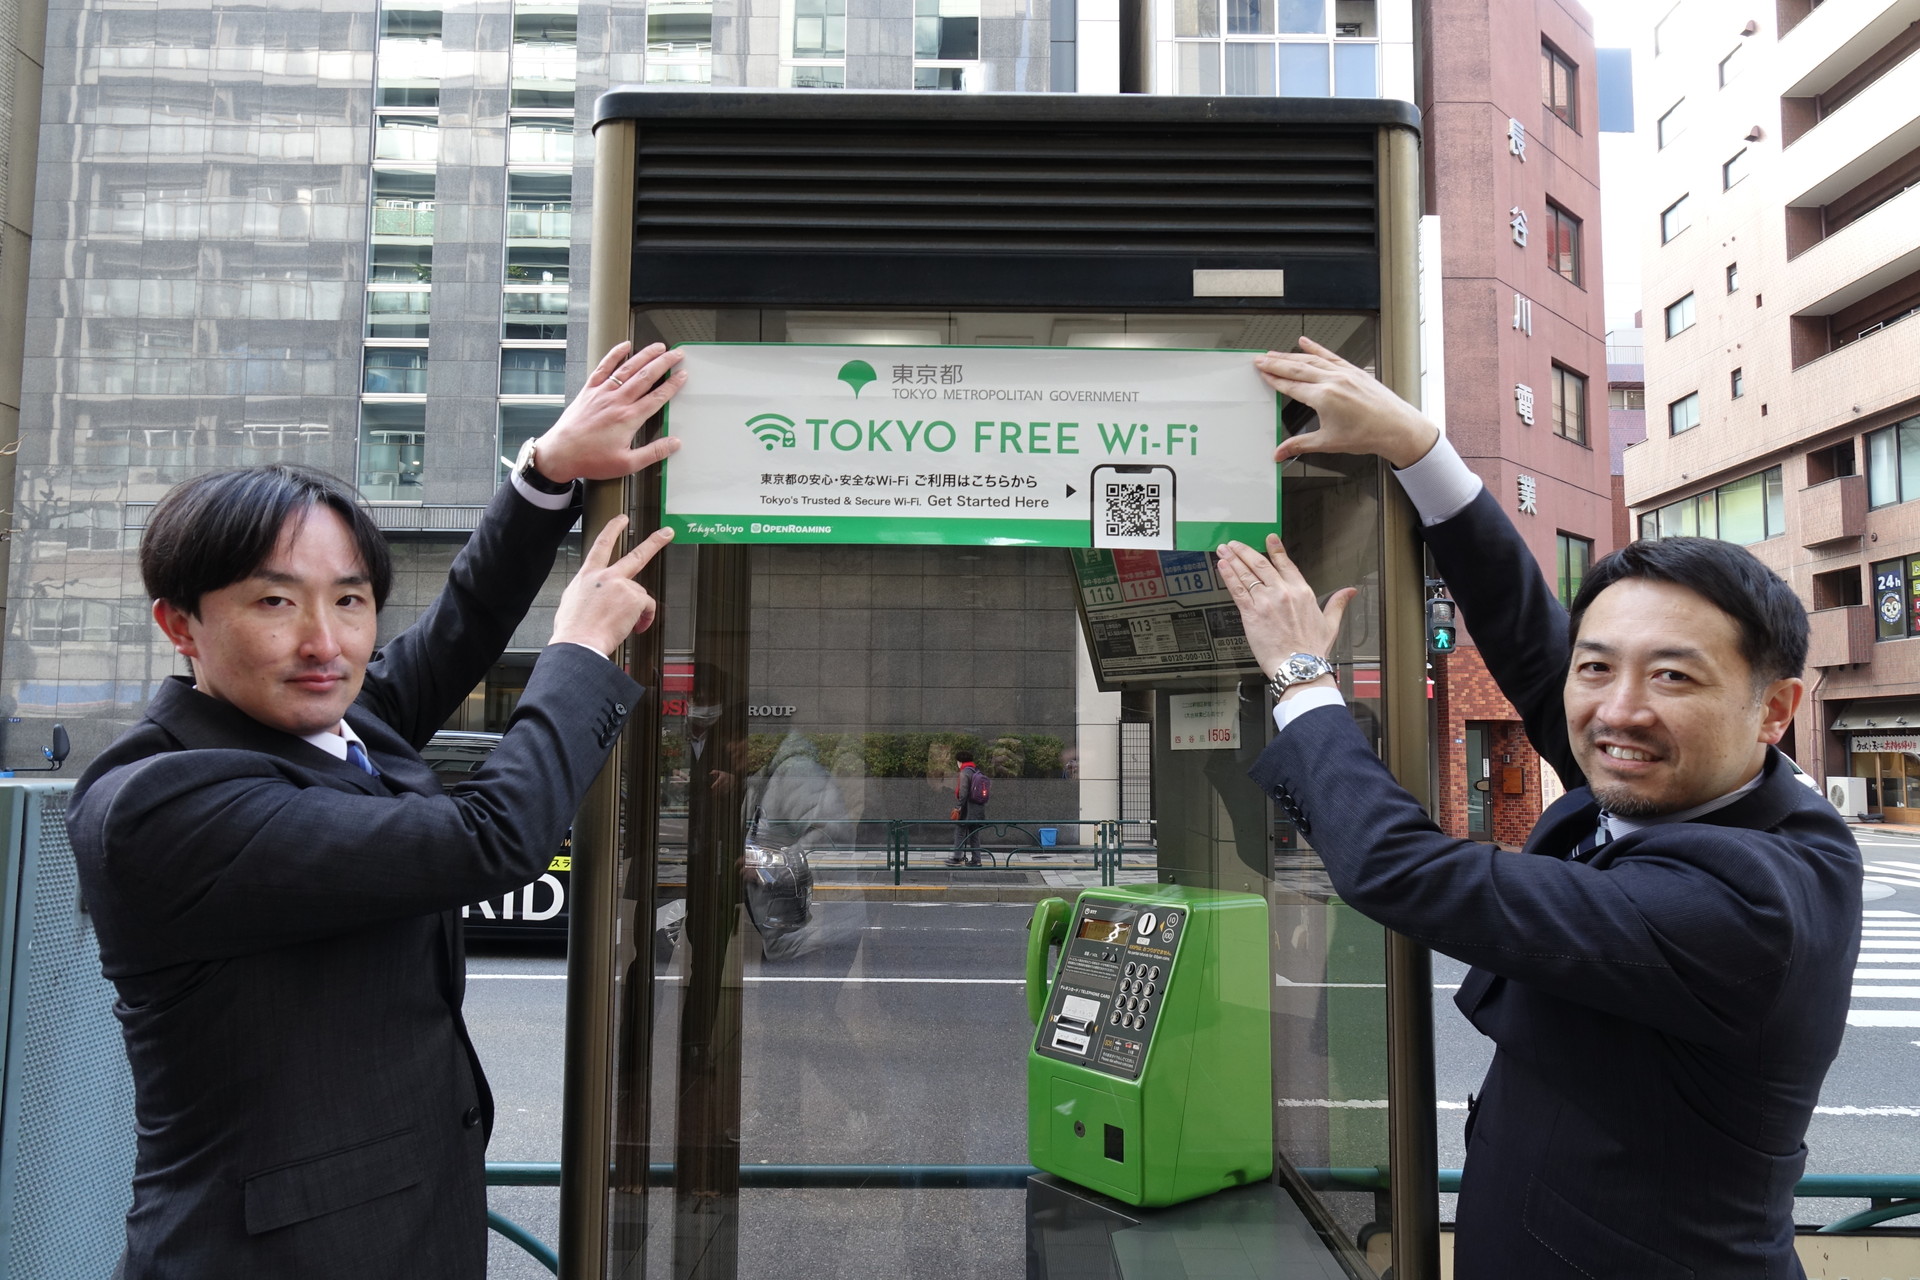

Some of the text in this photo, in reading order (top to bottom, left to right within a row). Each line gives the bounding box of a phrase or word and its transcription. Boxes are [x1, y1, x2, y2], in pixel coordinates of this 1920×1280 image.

[1507, 117, 1537, 515] 長谷川電業
[892, 364, 963, 385] 東京都
[892, 389, 1140, 402] TOKYO METROPOLITAN GOVERNMENT
[805, 418, 1199, 456] TOKYO FREE Wi-Fi
[760, 473, 1038, 488] 東京都の安心・安全なWi-Fi ご利用はこちらから
[760, 495, 1050, 508] Tokyo's Trusted & Secure Wi-Fi. Get Started Here
[714, 523, 744, 536] Tokyo
[1130, 580, 1158, 598] 119
[1174, 573, 1203, 592] 118
[1877, 574, 1901, 590] 24h
[1089, 586, 1115, 603] 110
[1130, 619, 1151, 633] 113
[1167, 652, 1212, 662] 0120-000-113
[1208, 729, 1231, 742] 1505
